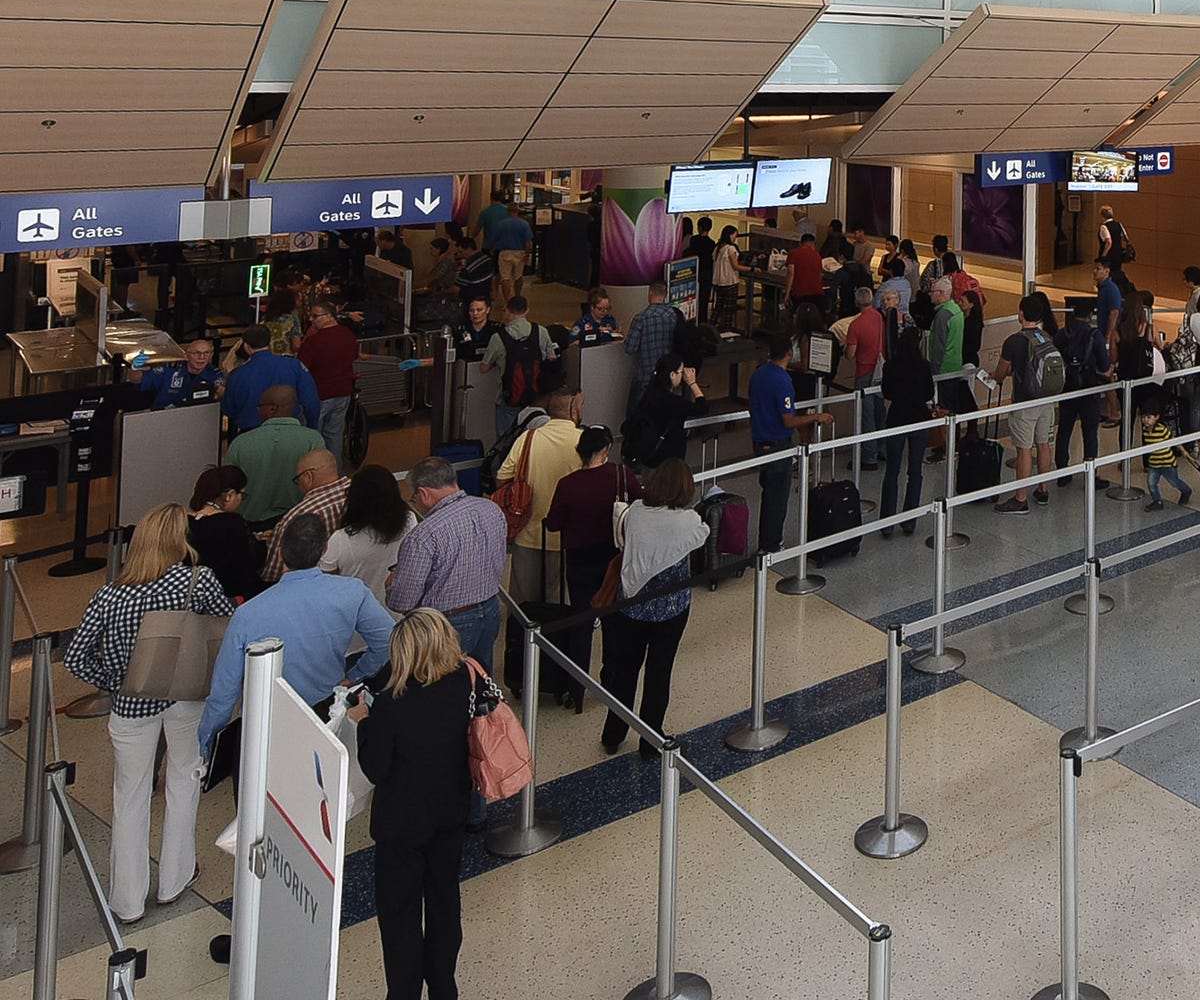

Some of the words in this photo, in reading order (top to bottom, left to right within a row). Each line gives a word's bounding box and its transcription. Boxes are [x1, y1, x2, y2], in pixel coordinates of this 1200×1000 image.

[1026, 160, 1036, 168] All
[1139, 164, 1154, 172] Enter
[1026, 171, 1046, 179] Gates
[342, 193, 361, 204] All
[72, 207, 97, 220] All
[320, 211, 360, 222] Gates
[72, 226, 123, 239] Gates
[784, 396, 791, 409] 3
[267, 836, 318, 924] PRIORITY
